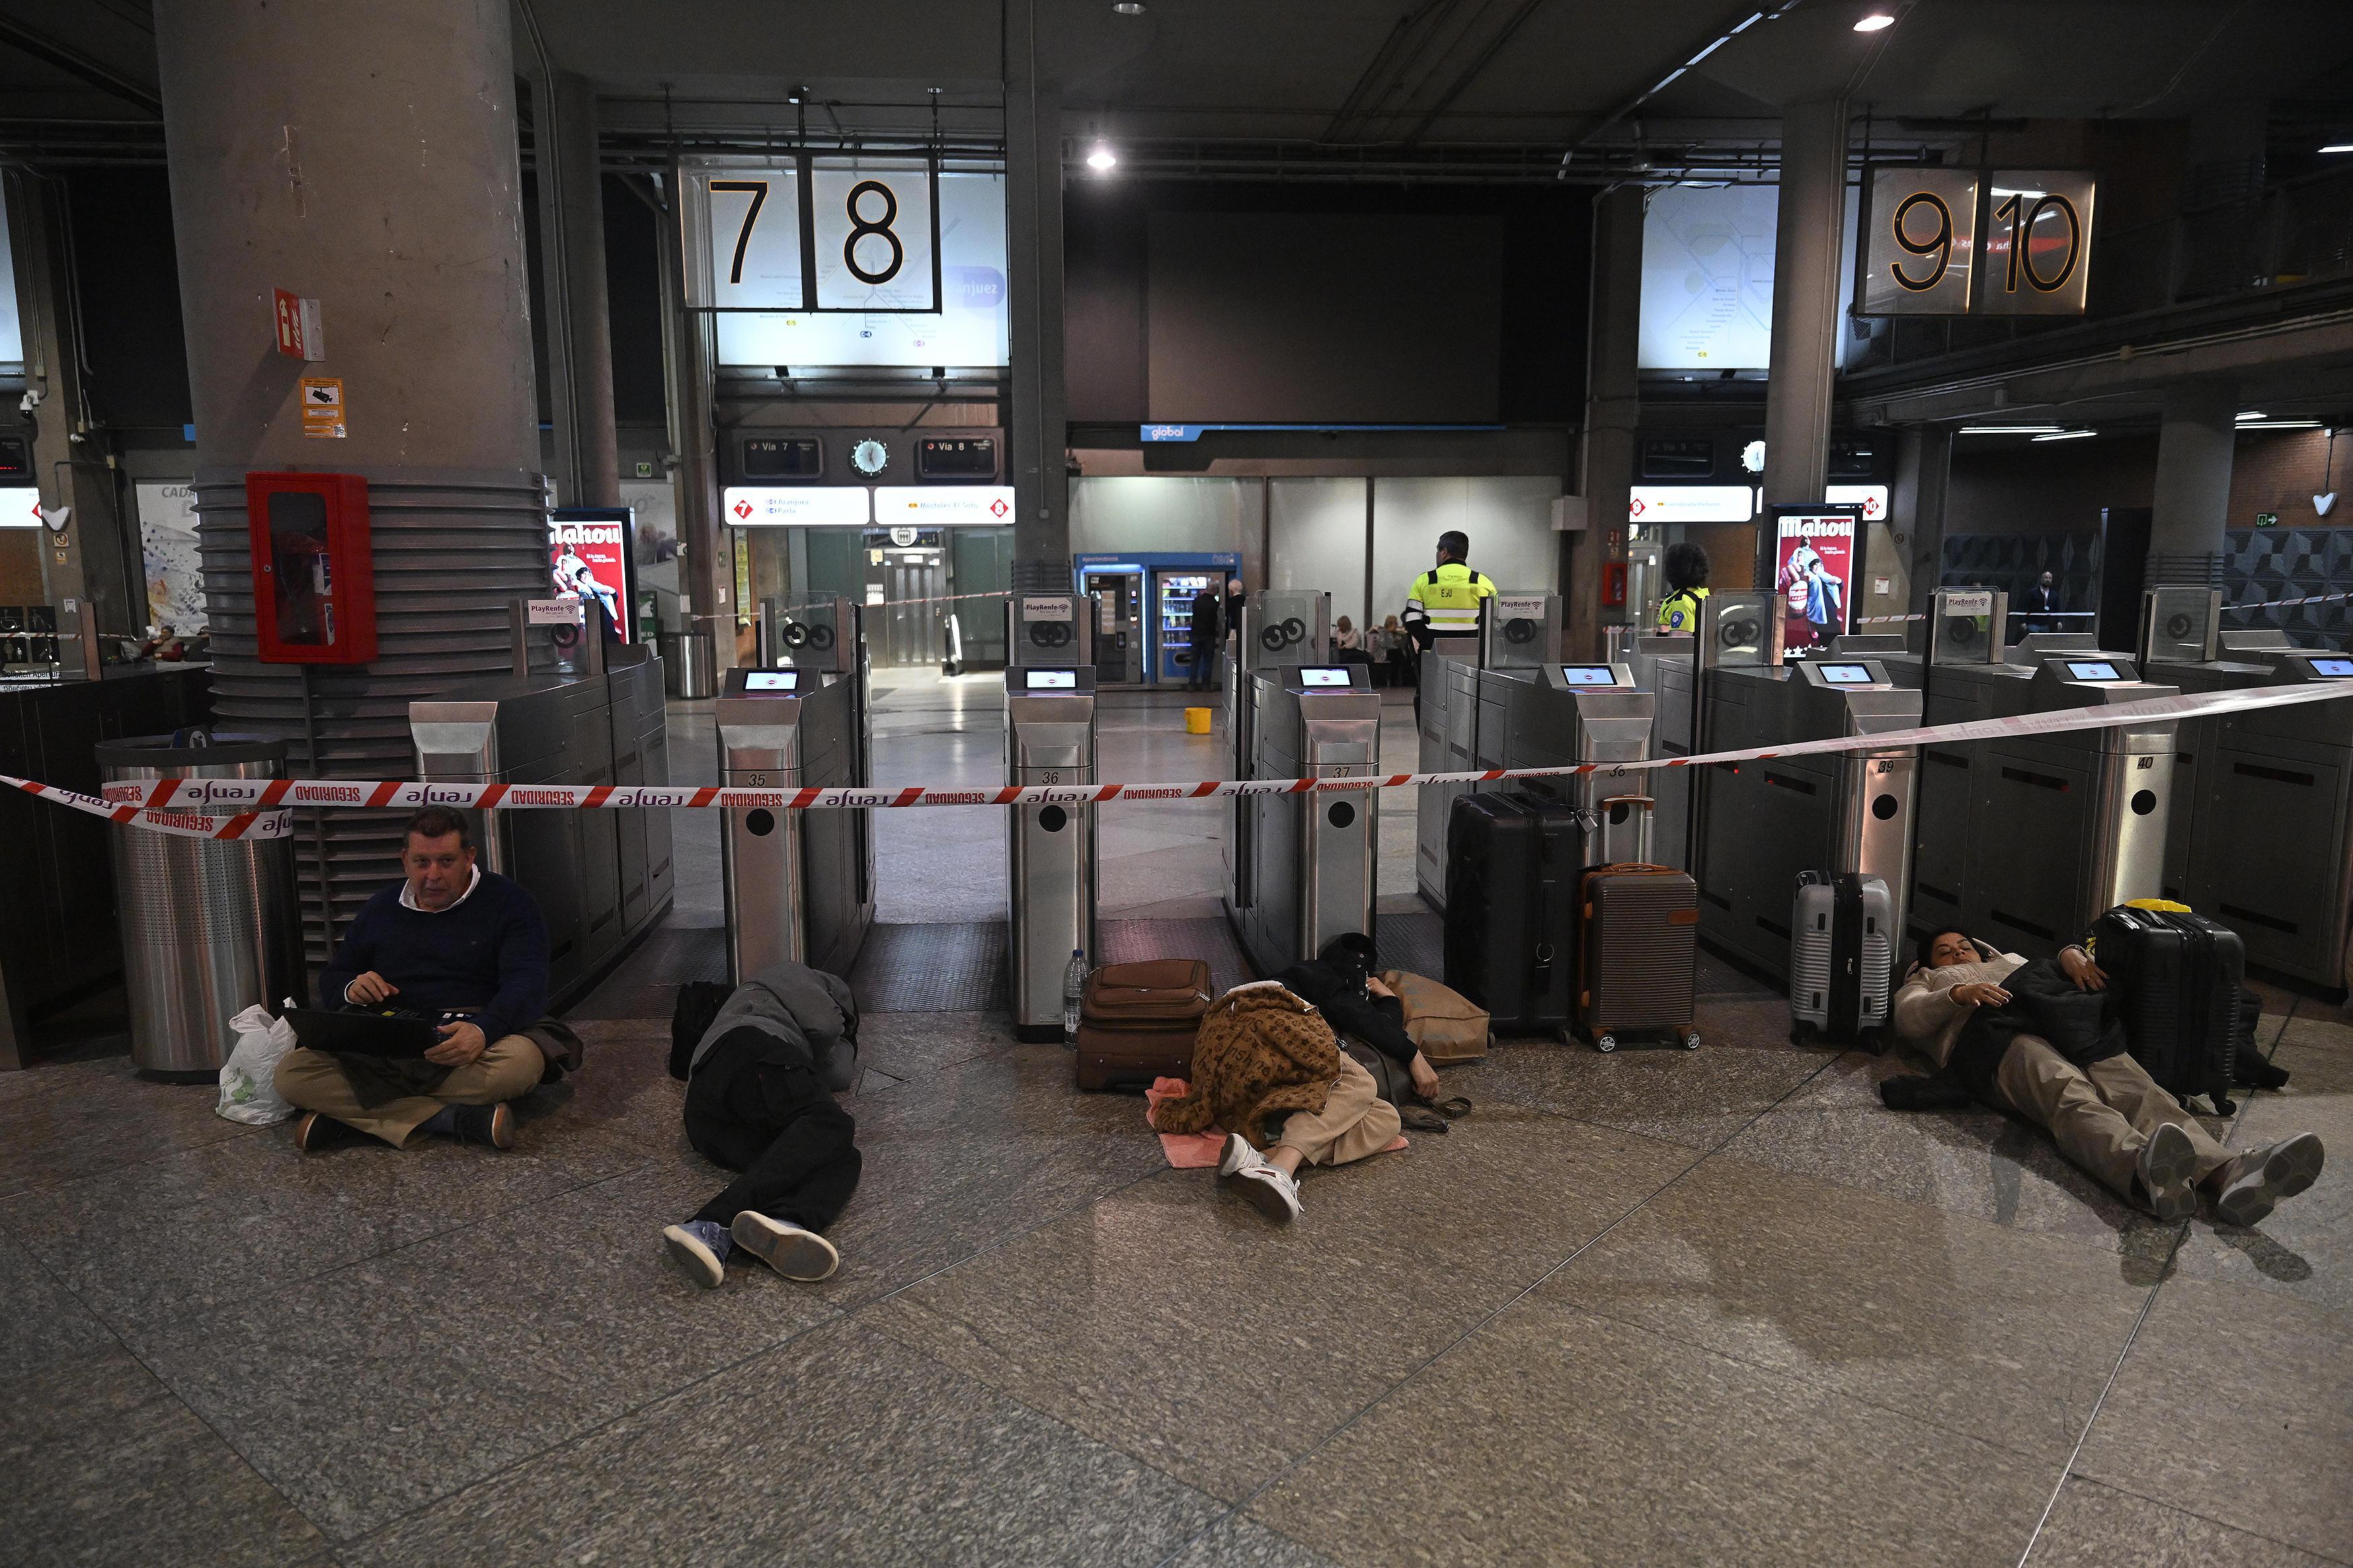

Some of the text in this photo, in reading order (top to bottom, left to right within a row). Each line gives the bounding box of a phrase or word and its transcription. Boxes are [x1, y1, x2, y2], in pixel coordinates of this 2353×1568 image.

[709, 180, 769, 284] 7
[844, 181, 904, 284] 8
[1890, 191, 1954, 292] 9
[1993, 191, 2082, 293] 10
[1152, 426, 1183, 440] global
[958, 443, 965, 451] 8
[739, 502, 748, 516] 7
[994, 501, 1004, 515] 8
[1632, 501, 1642, 514] 9
[1864, 501, 1877, 513] 10
[1781, 518, 1853, 538] Mahou
[1501, 601, 1531, 609] PlayRenfe
[1949, 598, 1978, 606] PlayRenfe
[531, 605, 564, 613] PlayRenfe
[1877, 761, 1894, 774] 39
[2137, 757, 2153, 770] 40
[1042, 771, 1059, 784] 36
[1333, 767, 1351, 779] 37
[748, 774, 766, 787] 35
[188, 780, 255, 805] renfe
[295, 786, 361, 802] SEGURIDAD
[407, 784, 473, 807] renfe
[511, 790, 574, 805] SEGURIDAD
[619, 788, 683, 807] renfe
[721, 792, 783, 807] SEGURIDAD
[826, 790, 889, 808] renfe
[925, 792, 985, 804] SEGURIDAD
[1027, 787, 1088, 803] renfe
[1123, 788, 1183, 800] SEGURIDAD
[1222, 782, 1283, 796] renfe
[146, 811, 214, 832] SEGURIDAD
[262, 811, 294, 837] nfe
